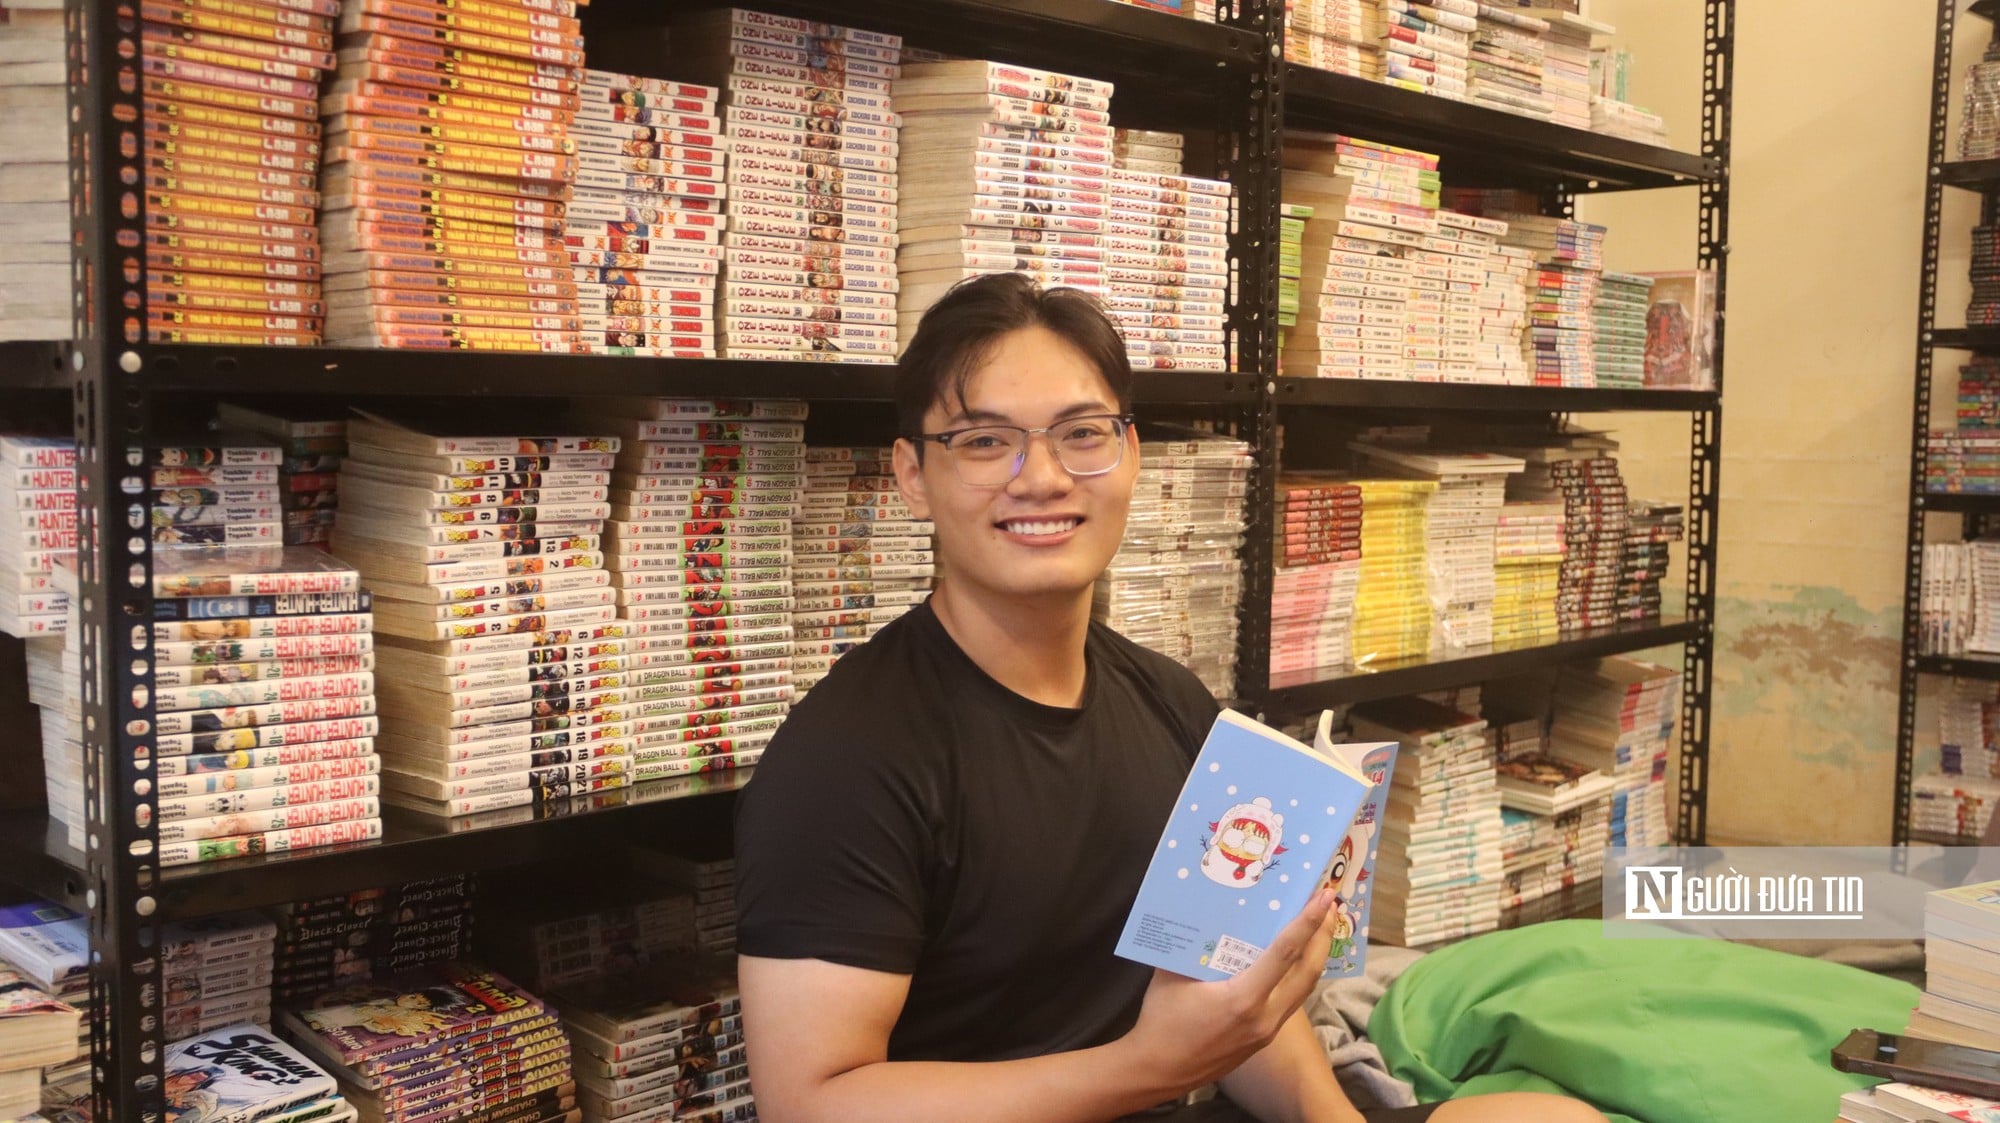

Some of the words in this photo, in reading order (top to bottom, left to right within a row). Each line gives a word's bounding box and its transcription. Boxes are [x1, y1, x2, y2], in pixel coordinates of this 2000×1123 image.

[745, 62, 764, 74] ONE
[766, 66, 796, 78] PIECE
[740, 80, 759, 90] ONE
[762, 82, 792, 94] PIECE
[745, 96, 764, 106] ONE
[766, 98, 796, 110] PIECE
[740, 110, 758, 122] ONE
[760, 113, 790, 125] PIECE
[500, 458, 510, 470] 10
[33, 471, 74, 488] HUNTER
[489, 476, 499, 488] 11
[35, 493, 76, 510] HUNTER
[486, 494, 496, 503] 8
[767, 494, 792, 502] DRAGON
[484, 530, 494, 538] 7
[756, 524, 780, 533] DRAGON
[546, 541, 556, 553] 13
[550, 560, 559, 568] 2
[740, 557, 754, 565] BALL
[756, 556, 781, 564] DRAGON
[740, 571, 754, 579] BALL
[756, 570, 781, 578] DRAGON
[258, 574, 296, 594] HUNTER
[303, 573, 341, 592] HUNTER
[490, 586, 500, 594] 5
[741, 590, 756, 598] BALL
[757, 588, 782, 598] DRAGON
[276, 594, 315, 614] HUNTER
[320, 592, 358, 613] HUNTER
[490, 603, 500, 612] 4
[743, 604, 758, 612] BALL
[760, 603, 784, 612] DRAGON
[276, 618, 314, 637] HUNTER
[320, 616, 357, 634] HUNTER
[491, 622, 501, 632] 3
[276, 638, 314, 658] HUNTER
[320, 636, 357, 656] HUNTER
[573, 647, 583, 660] 12
[282, 658, 320, 678] HUNTER
[324, 655, 360, 674] HUNTER
[574, 663, 584, 675] 14
[644, 670, 670, 680] DRAGON
[671, 668, 688, 678] BALL
[280, 681, 317, 700] HUNTER
[323, 678, 358, 697] HUNTER
[575, 680, 585, 692] 15
[642, 686, 668, 696] DRAGON
[670, 684, 686, 694] BALL
[326, 698, 360, 718] HUNTER
[576, 697, 586, 710] 16
[643, 702, 669, 712] DRAGON
[670, 700, 686, 709] BALL
[284, 701, 320, 722] HUNTER
[740, 710, 754, 718] BALL
[755, 707, 778, 716] DRAGON
[576, 716, 586, 727] 17
[737, 723, 752, 732] BALL
[753, 720, 776, 730] DRAGON
[285, 724, 322, 744] HUNTER
[328, 720, 363, 740] HUNTER
[576, 732, 586, 743] 18
[279, 745, 316, 764] HUNTER
[322, 740, 358, 759] HUNTER
[578, 748, 588, 760] 19
[289, 765, 325, 784] HUNTER
[330, 758, 366, 778] HUNTER
[575, 764, 586, 780] 20
[636, 766, 662, 776] DRAGON
[662, 764, 680, 772] BALL
[330, 780, 364, 800] HUNTER
[576, 780, 587, 794] 21
[288, 786, 324, 805] HUNTER
[287, 808, 324, 827] HUNTER
[330, 802, 364, 822] HUNTER
[290, 829, 326, 848] HUNTER
[332, 824, 368, 842] HUNTER
[201, 1034, 324, 1079] SHAMAN
